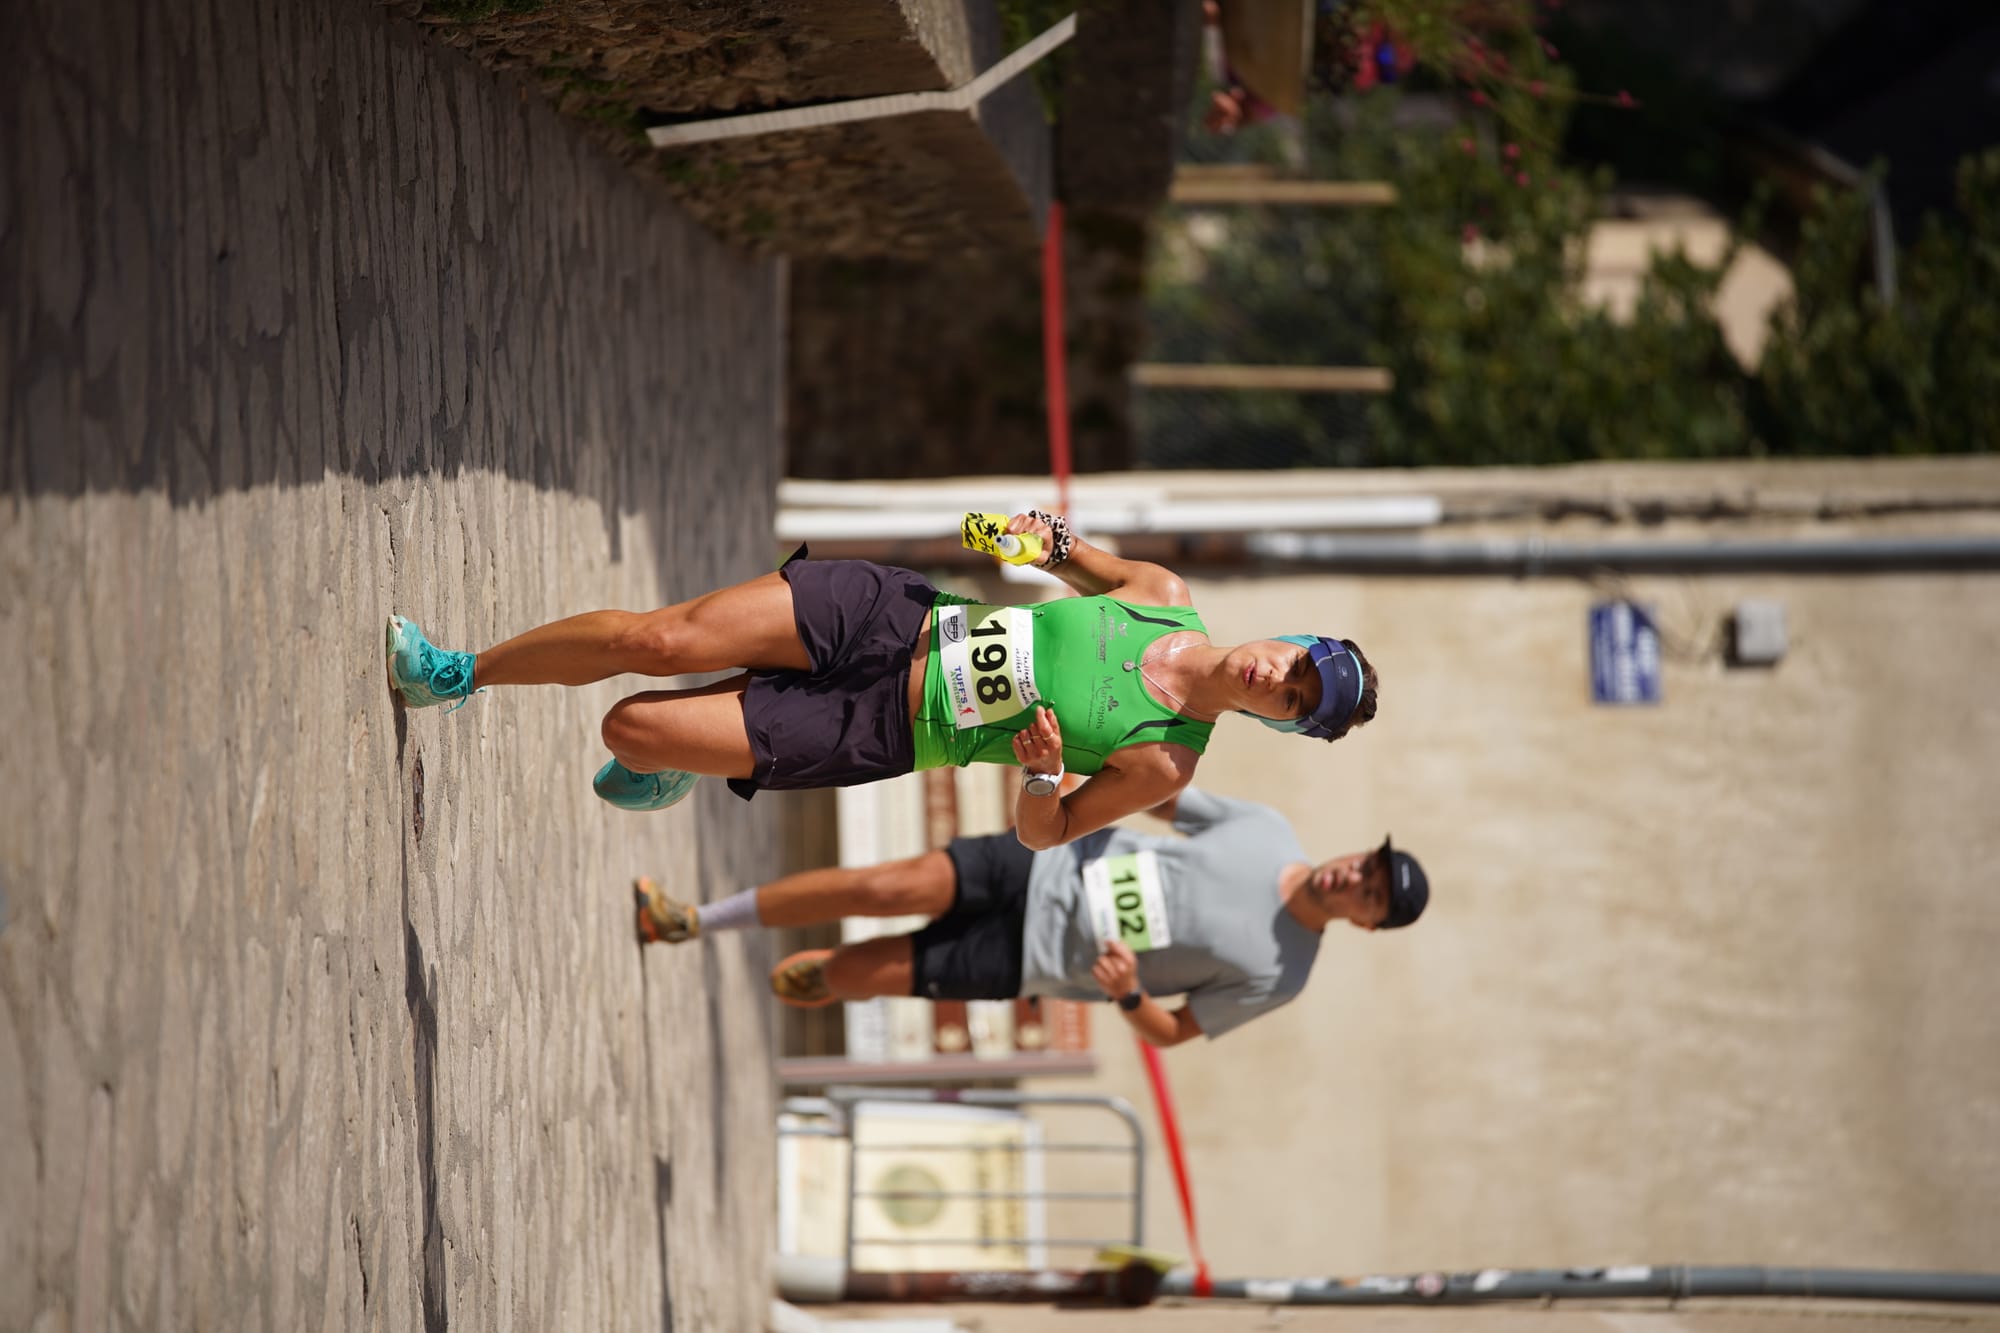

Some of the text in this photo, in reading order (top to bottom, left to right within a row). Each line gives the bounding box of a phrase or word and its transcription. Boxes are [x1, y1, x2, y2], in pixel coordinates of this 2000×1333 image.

[950, 616, 958, 639] BFP
[954, 666, 968, 705] TUFF'S
[971, 620, 1012, 705] 198
[1022, 651, 1031, 689] Challenge
[1095, 676, 1115, 730] Marvejols
[1112, 870, 1148, 937] 102
